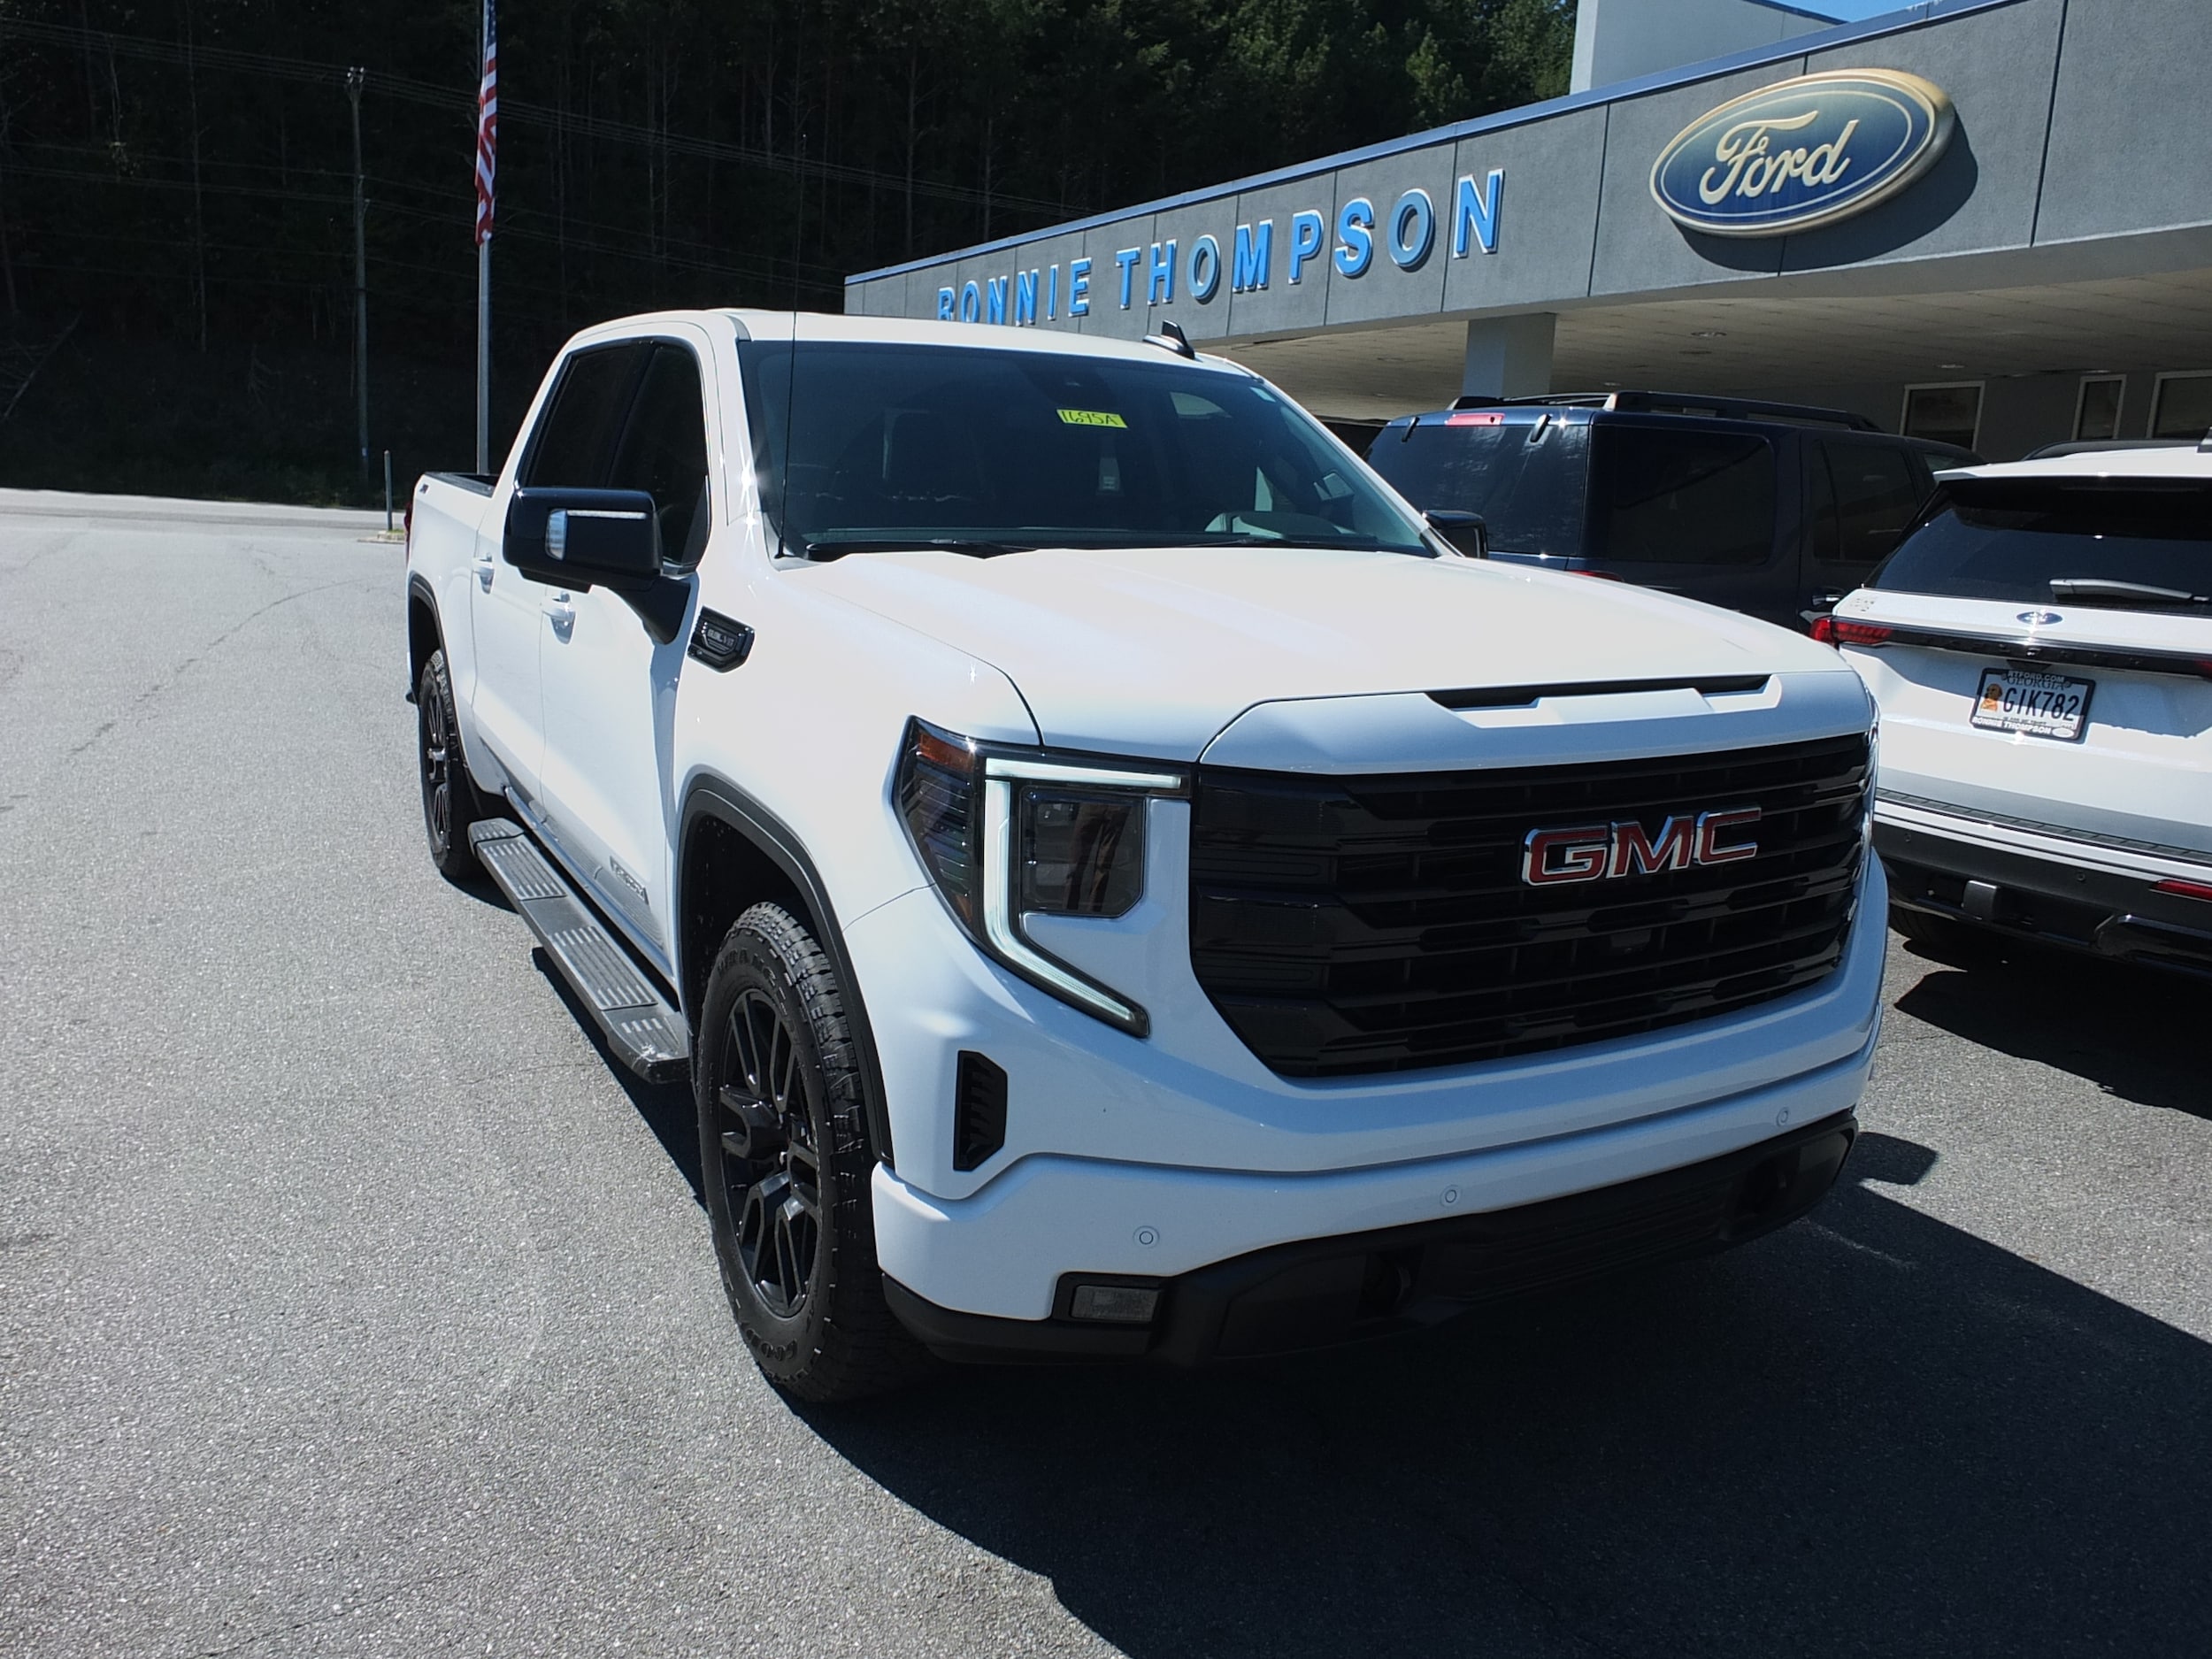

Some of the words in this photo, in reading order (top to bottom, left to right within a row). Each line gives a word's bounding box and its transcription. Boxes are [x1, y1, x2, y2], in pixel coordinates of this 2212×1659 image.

[1699, 110, 1860, 205] Ford
[936, 257, 1092, 326] RONNIE
[1116, 169, 1505, 310] THOMPSON
[2003, 687, 2079, 722] GIK782
[2003, 720, 2052, 734] THOMPSON
[1522, 807, 1762, 886] GMC
